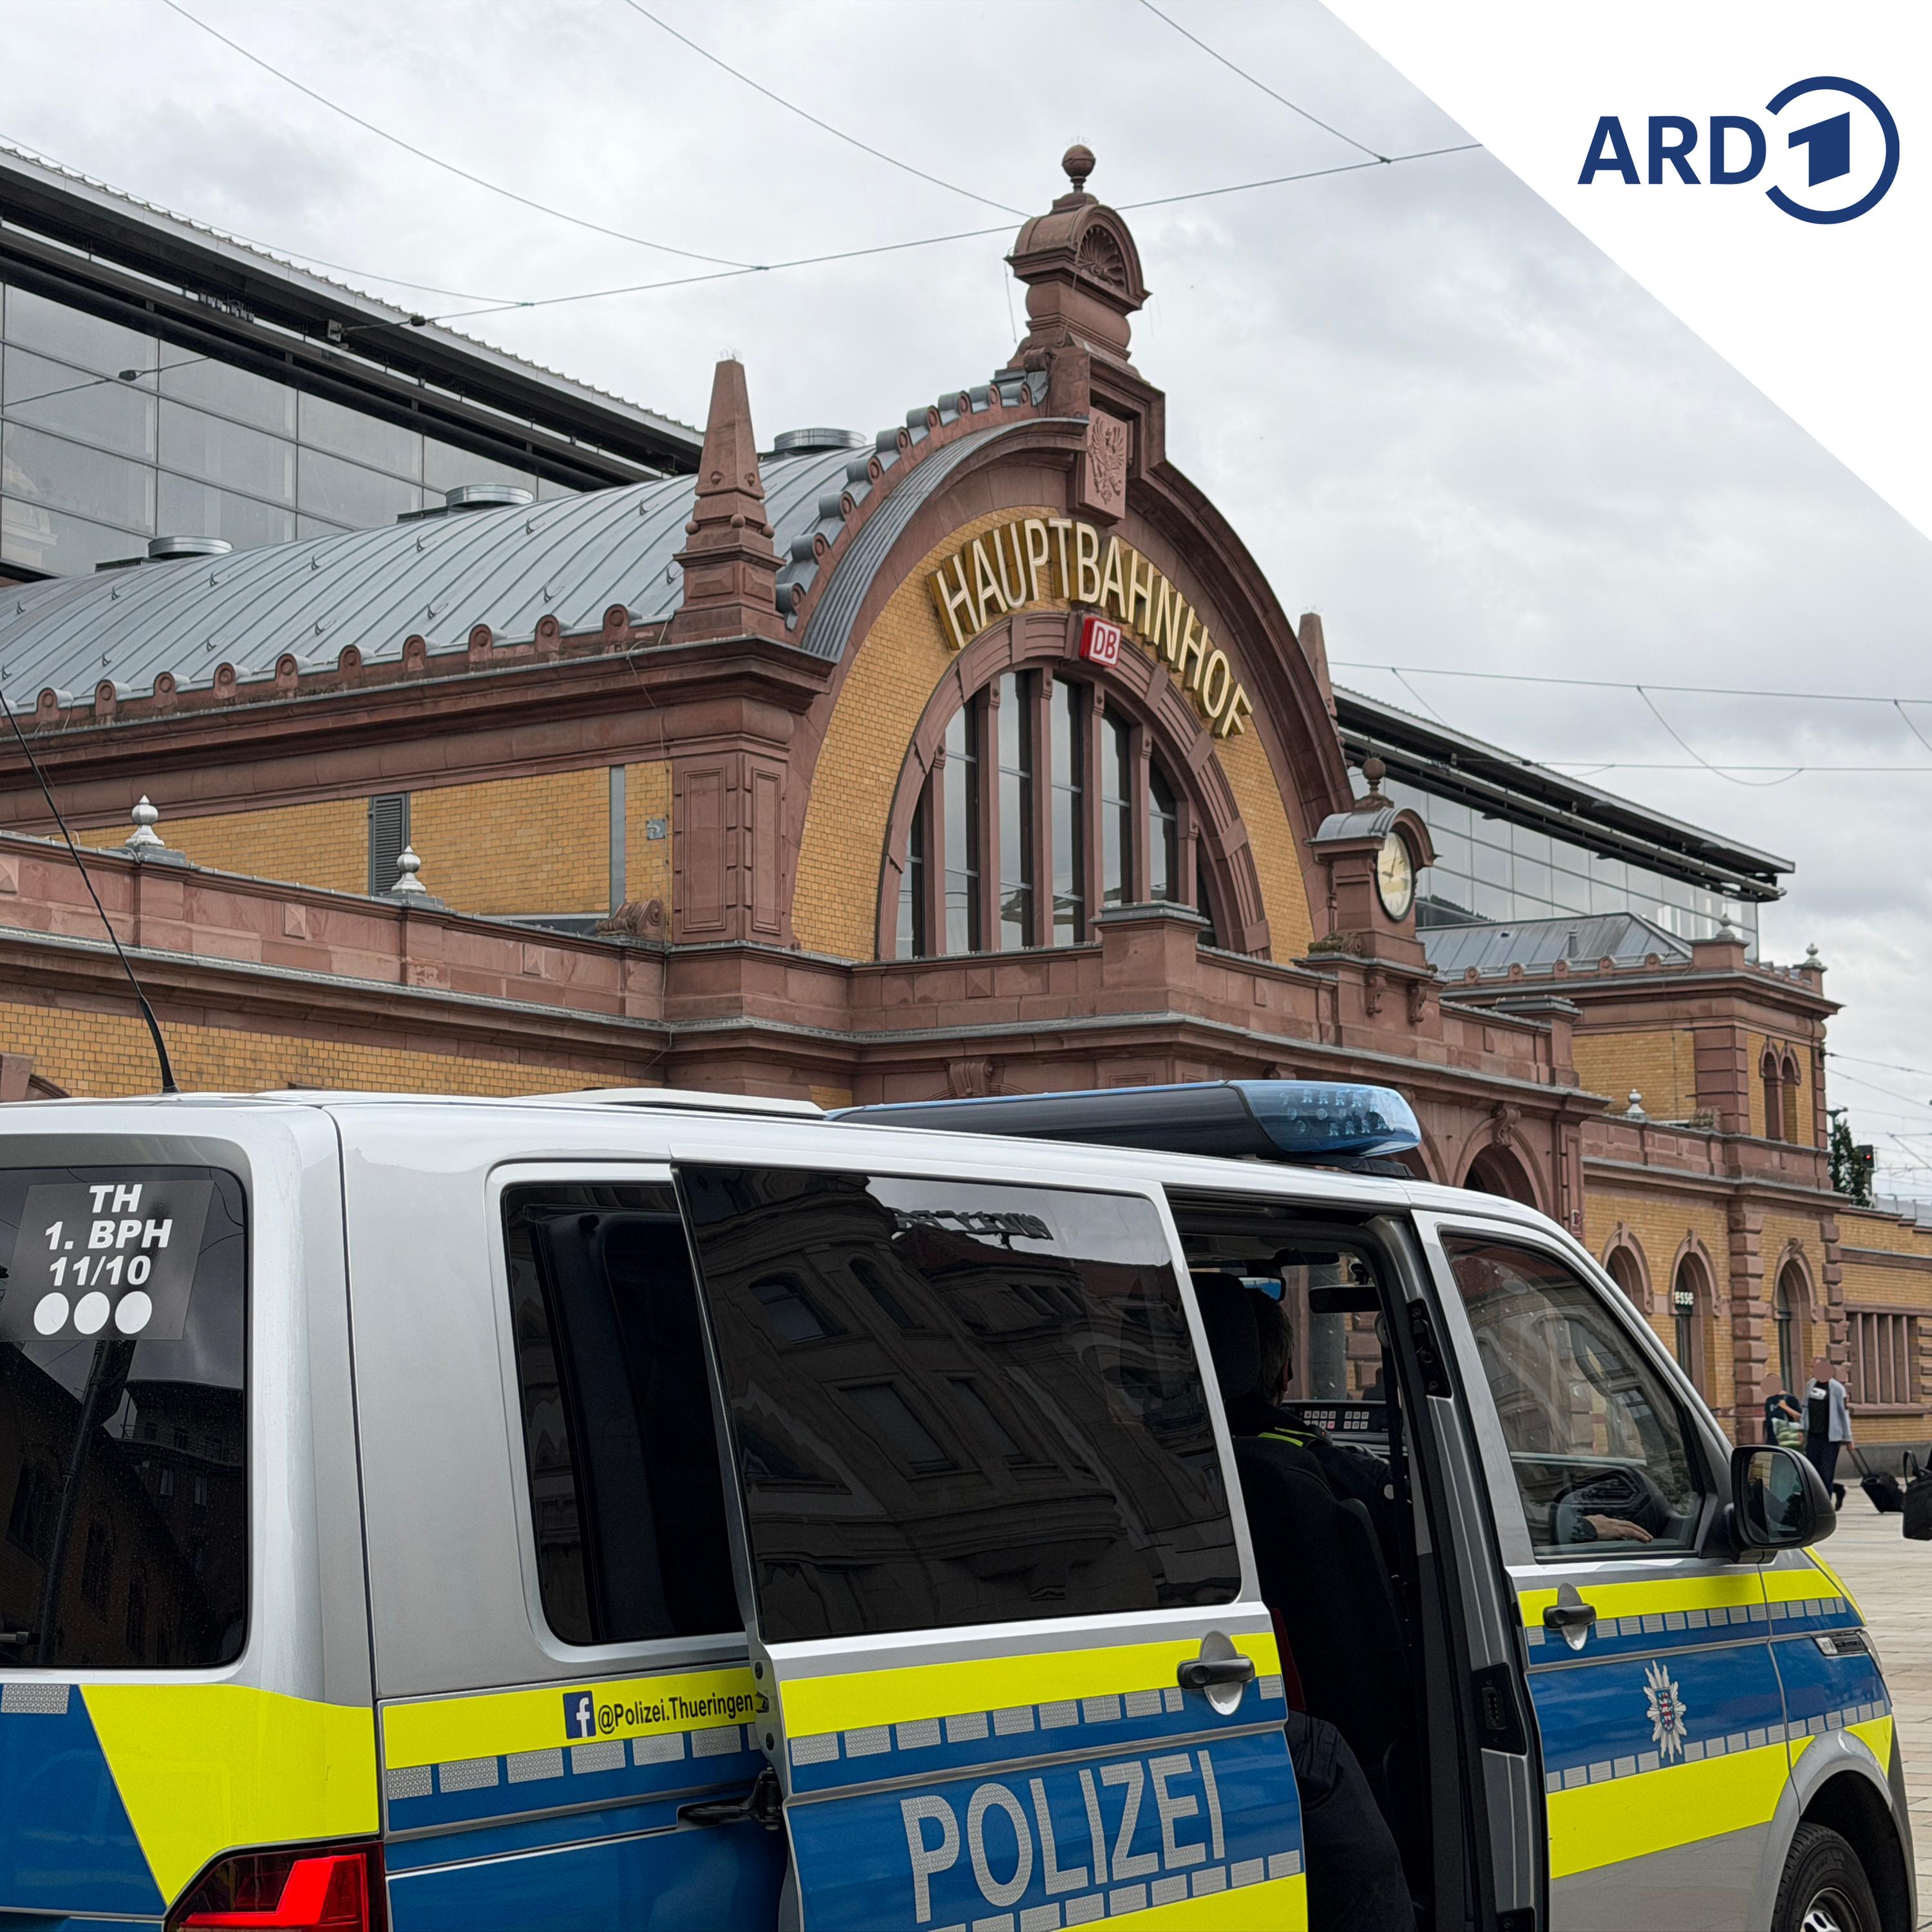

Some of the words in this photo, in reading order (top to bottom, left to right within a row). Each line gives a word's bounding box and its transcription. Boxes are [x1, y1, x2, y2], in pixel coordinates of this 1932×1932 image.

[934, 518, 1253, 738] HAUPTBAHNHOF
[1093, 625, 1117, 659] DB
[90, 1184, 143, 1213] TH
[44, 1221, 74, 1250] 1.
[88, 1218, 173, 1249] BPH
[49, 1255, 151, 1287] 11/10
[598, 1692, 754, 1735] @Polizei.Thueringen
[900, 1749, 1225, 1924] POLIZEI
